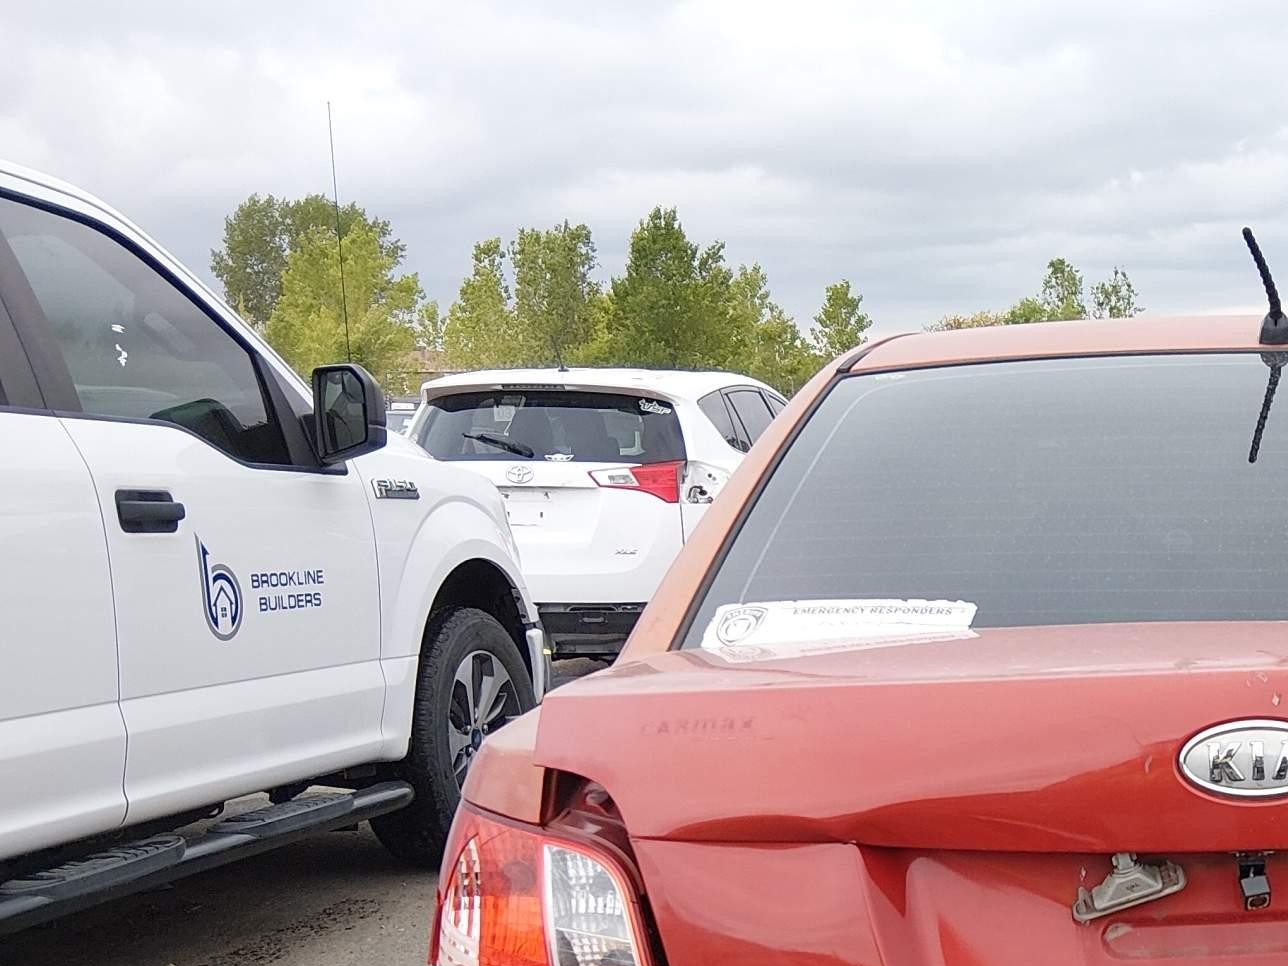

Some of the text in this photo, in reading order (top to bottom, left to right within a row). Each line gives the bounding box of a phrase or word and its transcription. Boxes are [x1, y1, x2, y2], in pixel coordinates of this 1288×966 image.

[251, 570, 324, 589] BROOKLINE
[259, 593, 321, 612] BUILDERS
[793, 606, 952, 616] EMERGENCY RESPONDERS
